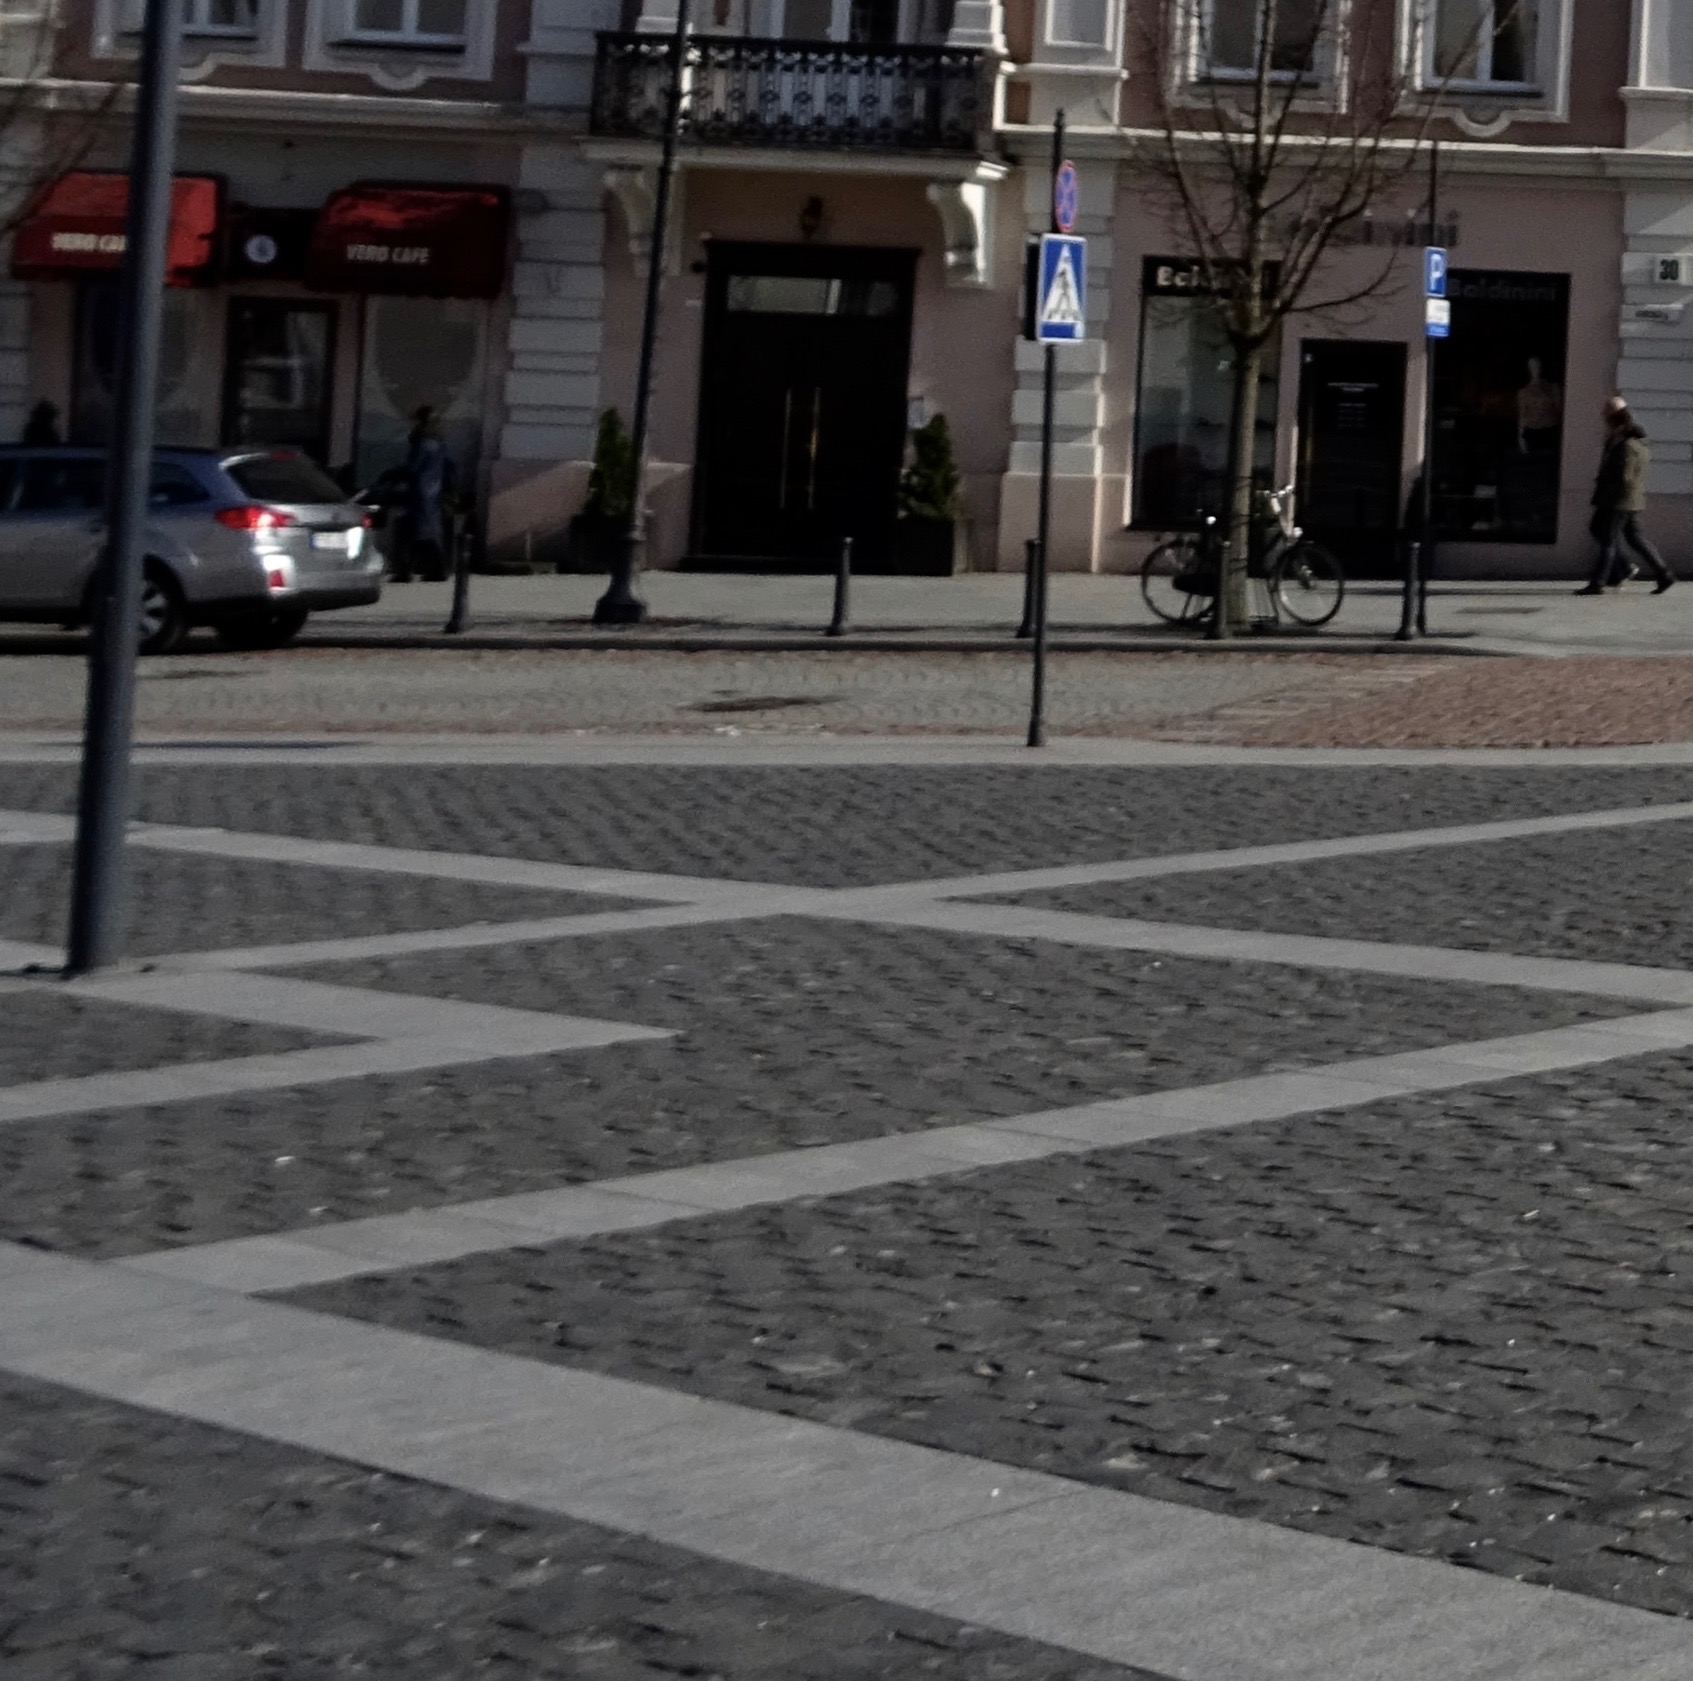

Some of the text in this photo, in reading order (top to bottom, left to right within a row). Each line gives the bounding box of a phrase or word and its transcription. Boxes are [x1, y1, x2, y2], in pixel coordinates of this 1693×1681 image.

[346, 243, 389, 263] VERO
[1429, 252, 1444, 291] P
[1660, 258, 1679, 280] 30
